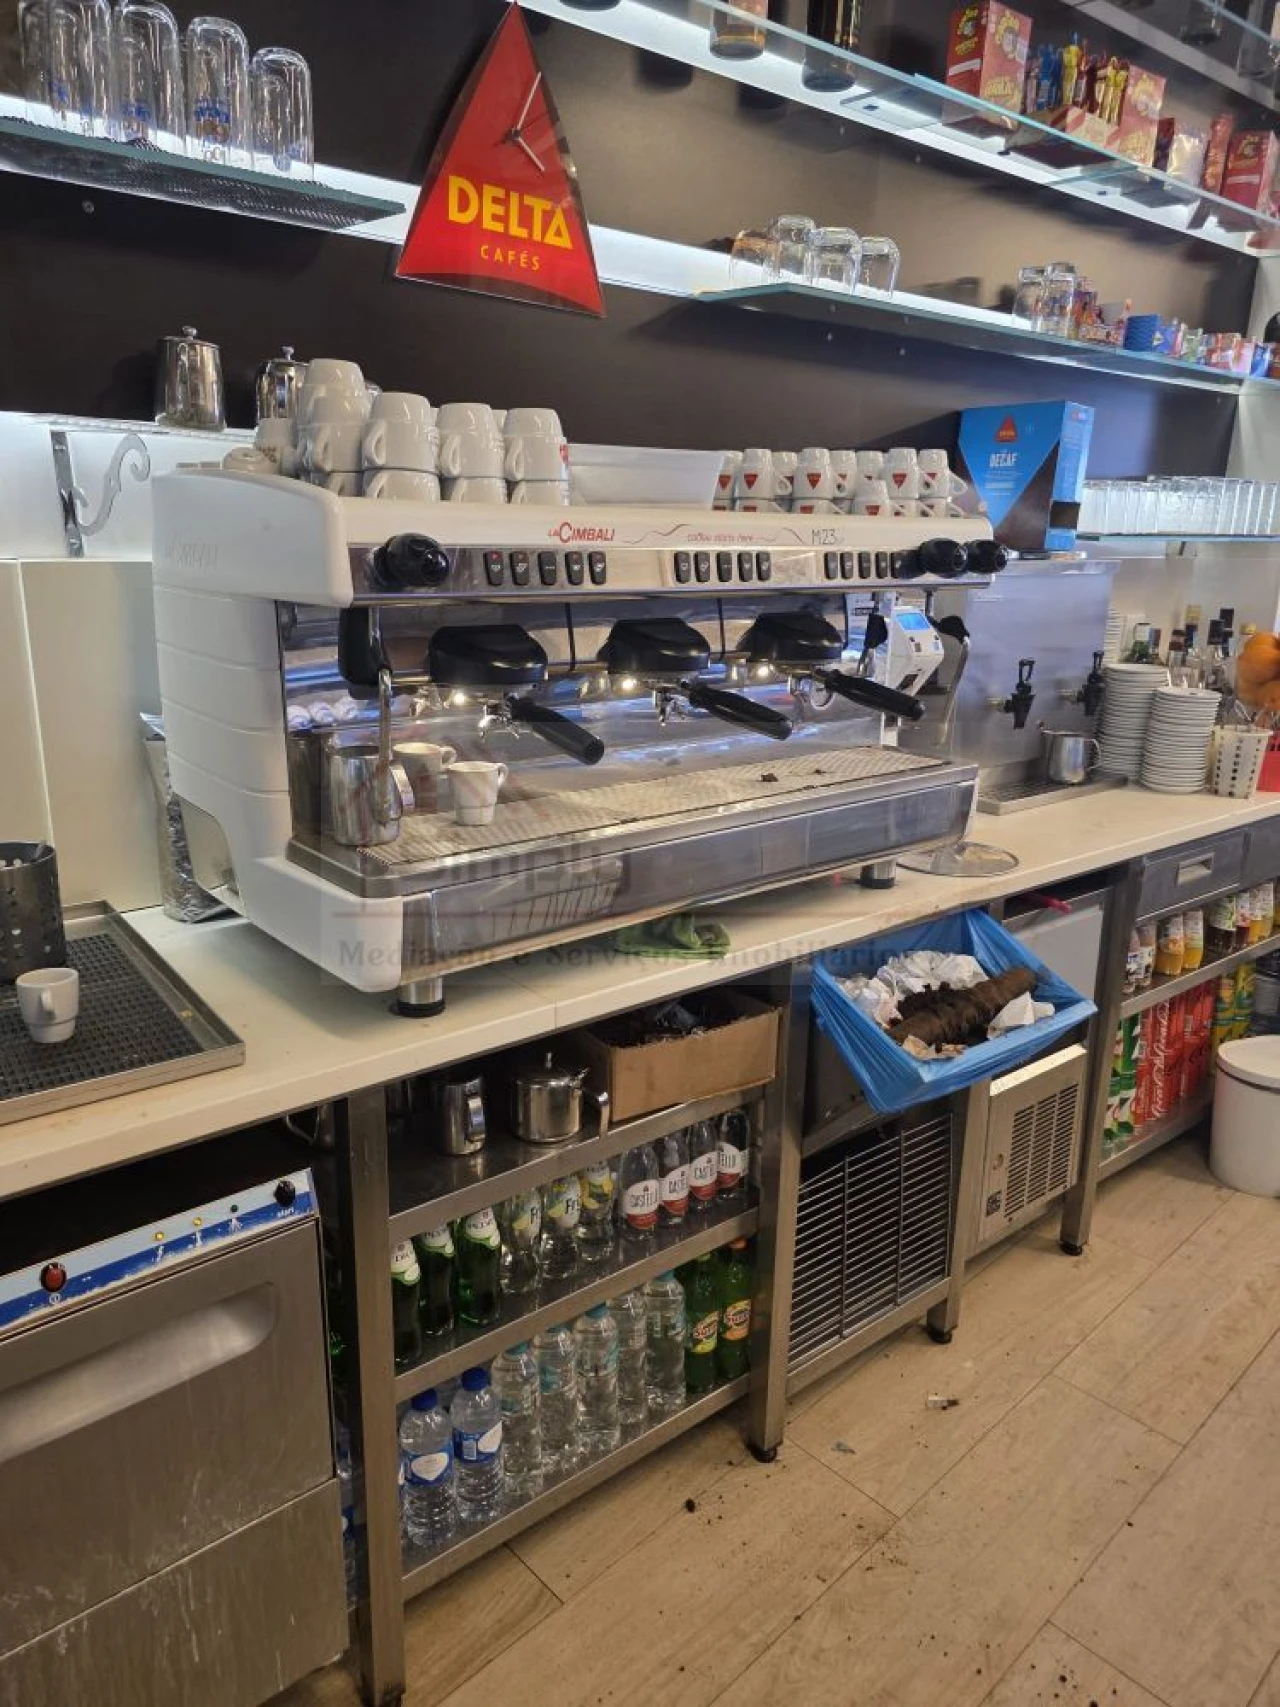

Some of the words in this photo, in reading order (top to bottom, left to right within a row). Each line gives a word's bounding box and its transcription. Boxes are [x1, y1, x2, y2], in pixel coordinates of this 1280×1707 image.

[448, 175, 573, 249] DELTA
[480, 245, 540, 271] CAFÉS
[559, 521, 616, 544] CIMBALI
